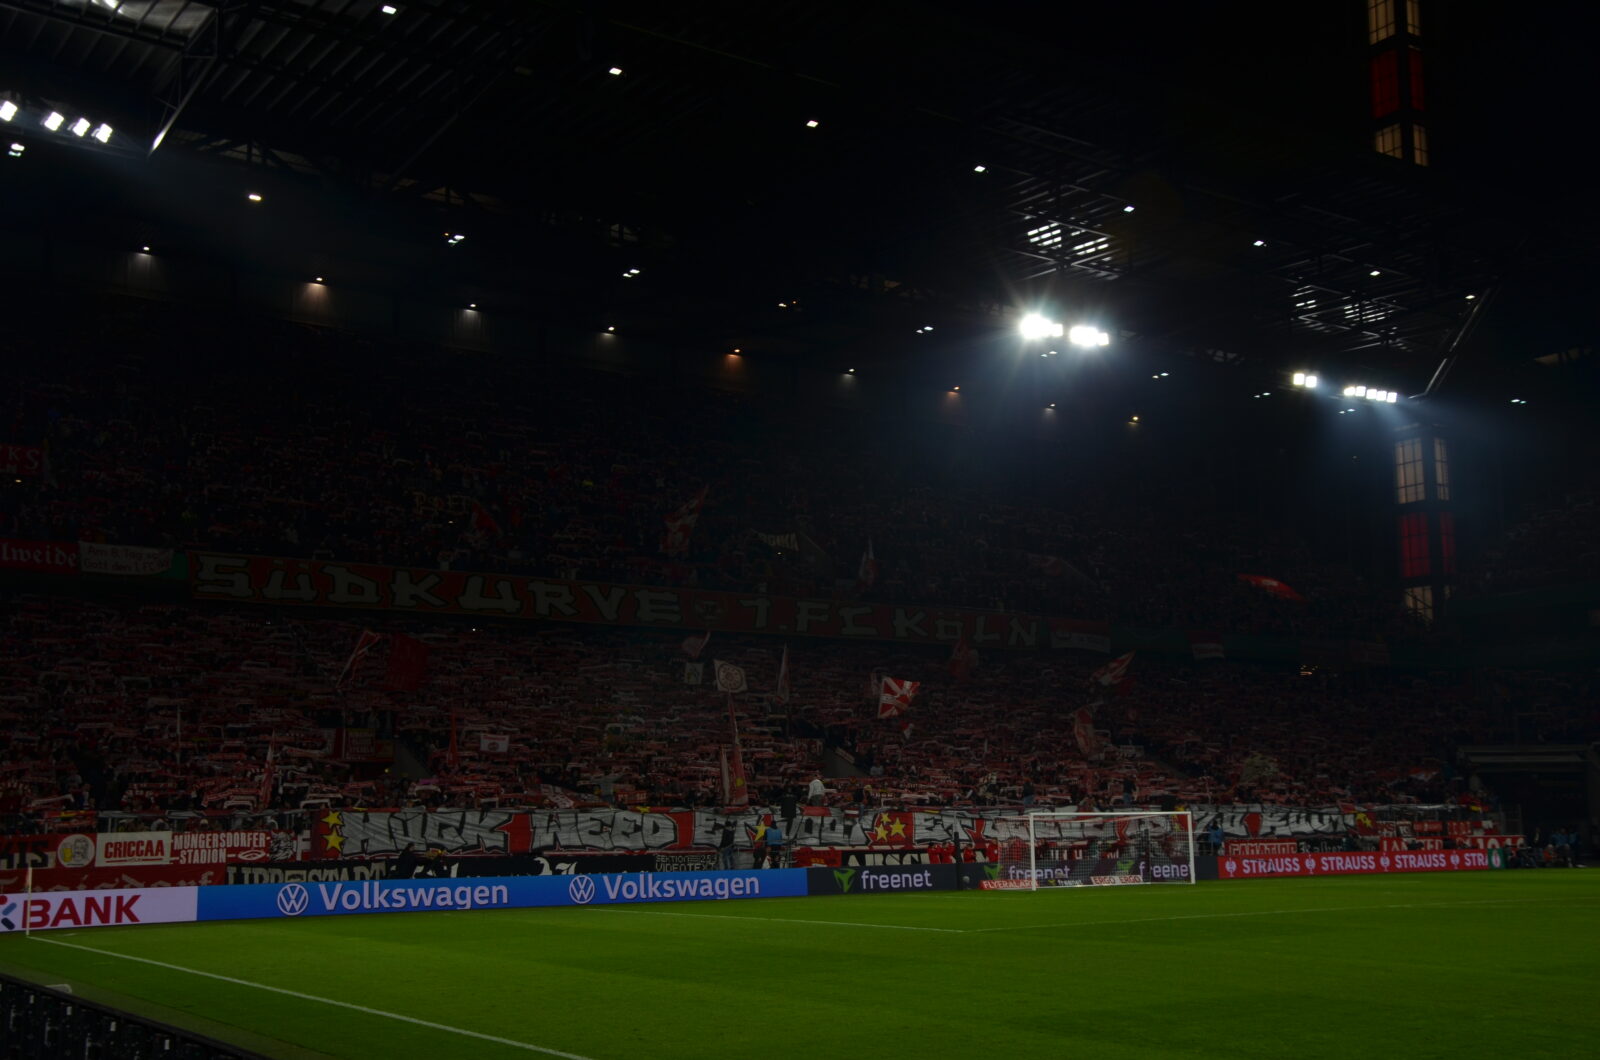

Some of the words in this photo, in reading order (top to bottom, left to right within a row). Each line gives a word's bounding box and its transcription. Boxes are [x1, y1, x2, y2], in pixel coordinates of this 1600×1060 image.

[195, 554, 684, 623] SÜDKURVE
[104, 839, 165, 859] CRICCAA
[180, 849, 227, 866] STADION
[1241, 858, 1300, 875] STRAUSS
[1320, 855, 1376, 872] STRAUSS
[1394, 853, 1447, 869] STRAUSS
[602, 872, 761, 900] Volkswagen
[861, 870, 933, 890] freenet
[318, 880, 510, 911] Volkswagen
[21, 895, 142, 929] BANK
